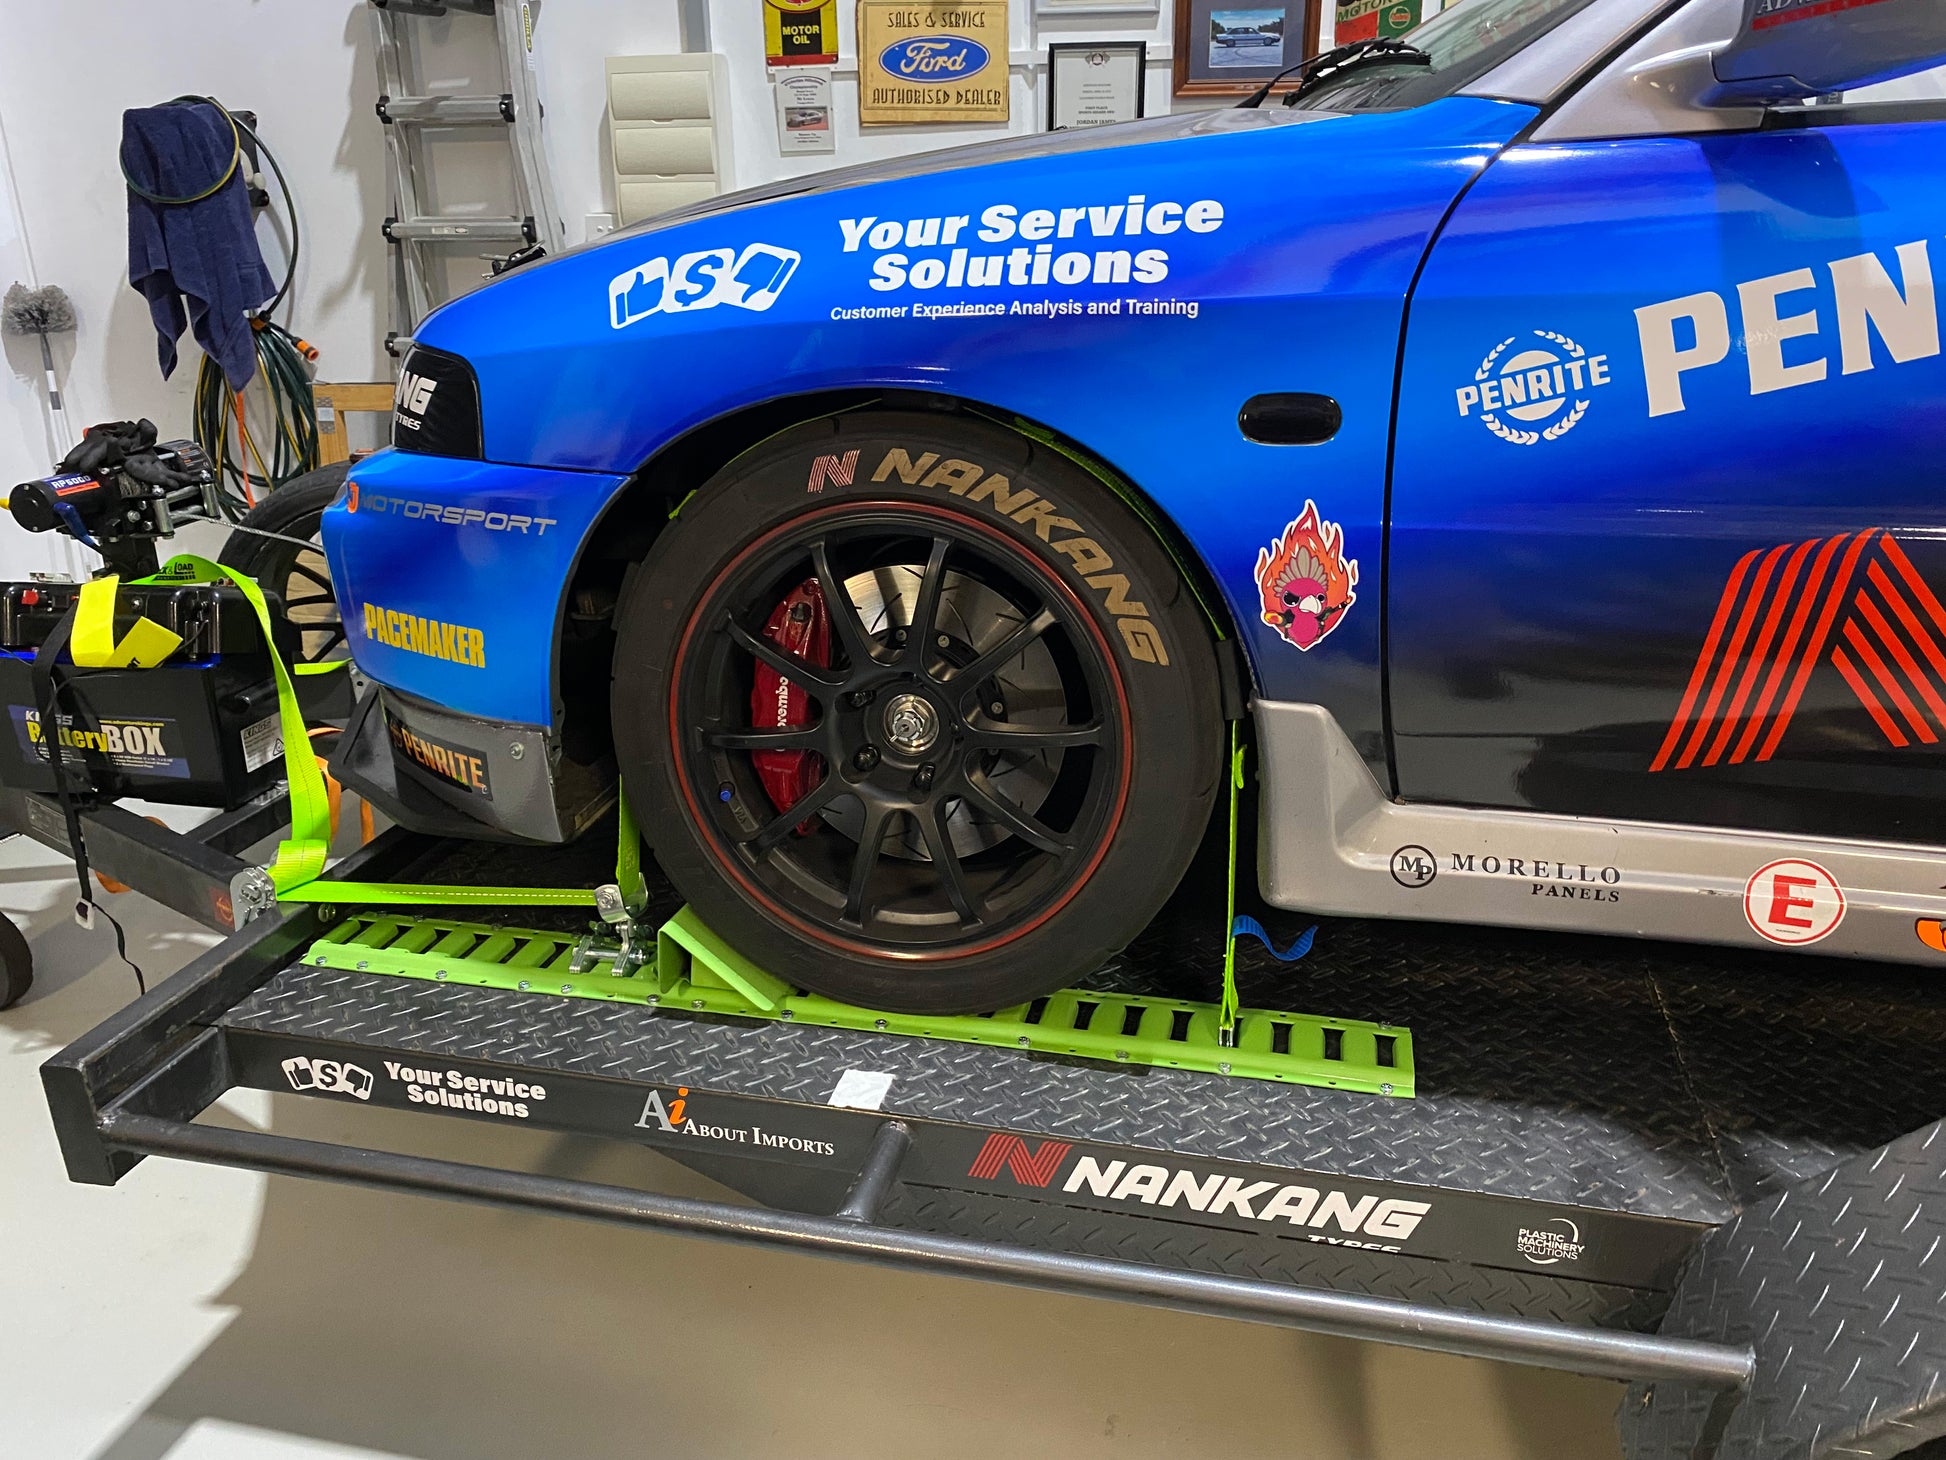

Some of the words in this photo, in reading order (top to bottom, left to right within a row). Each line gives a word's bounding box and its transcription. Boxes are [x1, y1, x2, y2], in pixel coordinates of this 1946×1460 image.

[782, 25, 820, 35] MOTOR
[887, 11, 920, 28] SALES
[925, 13, 936, 28] &
[940, 11, 986, 28] SERVICE
[792, 35, 811, 45] OIL
[900, 42, 968, 74] Ford
[872, 88, 950, 105] AUTHORISED
[955, 89, 1001, 105] DEALER
[838, 215, 969, 252] Your
[976, 195, 1224, 242] Service
[868, 244, 1169, 291] Solutions
[830, 305, 906, 321] Customer
[912, 301, 1006, 318] Experience
[1010, 298, 1083, 319] Analysis
[1087, 299, 1120, 315] and
[1125, 297, 1199, 318] Training
[1633, 239, 1940, 418] PEN
[1456, 354, 1611, 416] PENRITE
[362, 492, 557, 536] MOTORSPORT
[871, 448, 1170, 667] NANKANG
[363, 602, 486, 668] PACEMAKER
[401, 727, 485, 789] PENRITE
[1451, 852, 1622, 885] MORELLO
[1531, 883, 1620, 903] PANELS
[1768, 874, 1817, 929] E
[383, 1060, 443, 1086] Your
[446, 1070, 547, 1100] Service
[406, 1084, 530, 1118] Solutions
[1062, 1155, 1432, 1240] NANKANG
[1516, 1243, 1579, 1260] SOLUTIONS
[1517, 1236, 1585, 1253] MACHINERY
[1518, 1228, 1565, 1243] PLASTIC
